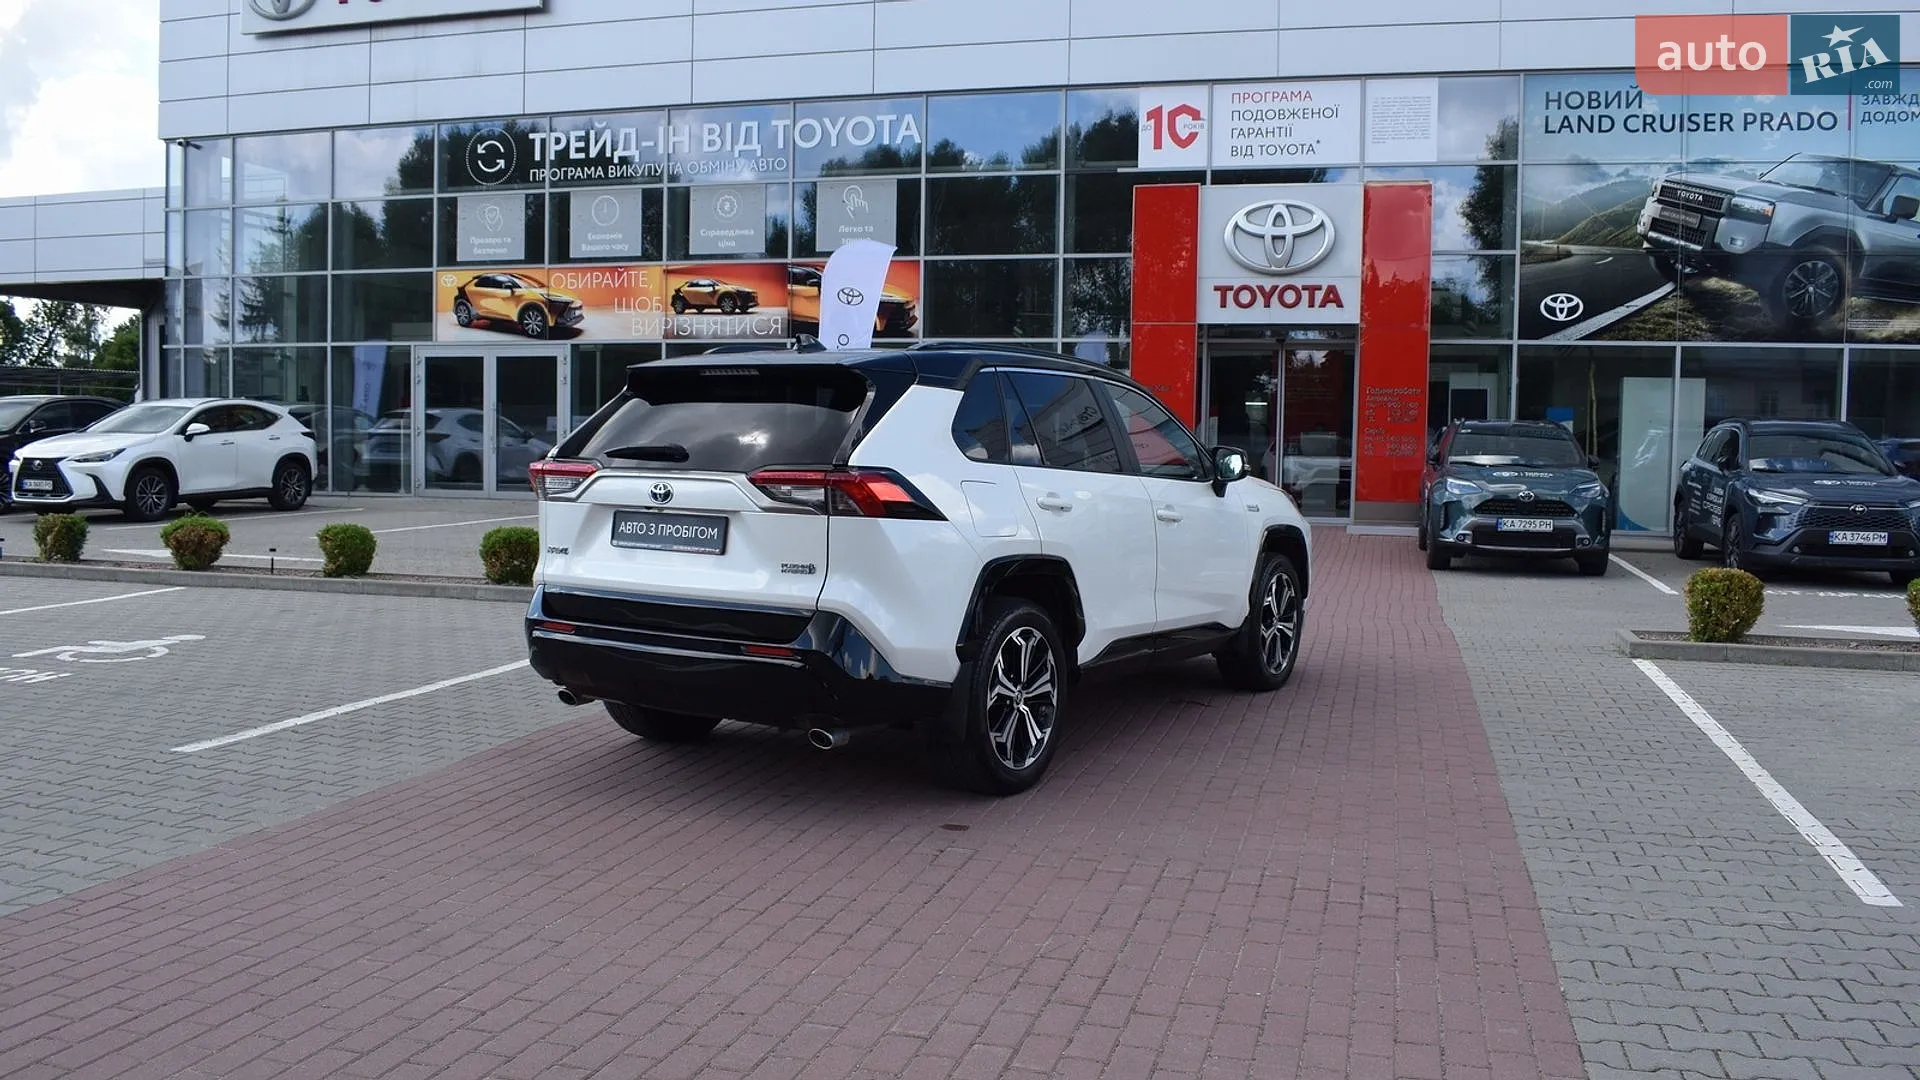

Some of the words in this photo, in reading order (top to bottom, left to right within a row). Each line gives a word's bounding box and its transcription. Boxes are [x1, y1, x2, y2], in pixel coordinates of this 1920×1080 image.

[1231, 90, 1313, 104] ПРОГРАМА
[1545, 85, 1643, 110] НОВИЙ
[1231, 104, 1340, 122] ПОДОВЖЕНОЇ
[1231, 124, 1293, 139] ГАРАНТІЇ
[1544, 113, 1615, 134] LAND
[1623, 112, 1734, 133] CRUISER
[1743, 111, 1838, 132] PRADO
[529, 121, 690, 163] ТРЕЙД-ІН
[703, 121, 762, 158] ВІД
[771, 113, 922, 149] TOYOTA
[1231, 145, 1254, 158] ВІД
[529, 166, 603, 182] ПРОГРАМА
[609, 163, 663, 178] ВИКУПУ
[668, 161, 683, 175] ТА
[687, 159, 748, 175] ОБМІНУ
[750, 157, 787, 172] АВТО
[1677, 190, 1703, 202] TOYOTA
[551, 268, 653, 289] ОБИРАЙТЕ,
[614, 296, 663, 314] ЩОБ
[1213, 284, 1344, 309] TOYOTA
[631, 315, 782, 337] ВИРІЗНЯТИСЯ
[618, 521, 646, 534] АВТО
[657, 524, 718, 540] ПРОБІГОМ
[1518, 519, 1537, 529] 7295
[1834, 532, 1848, 541] KA
[1850, 532, 1871, 541] 3746
[1872, 533, 1887, 542] PM
